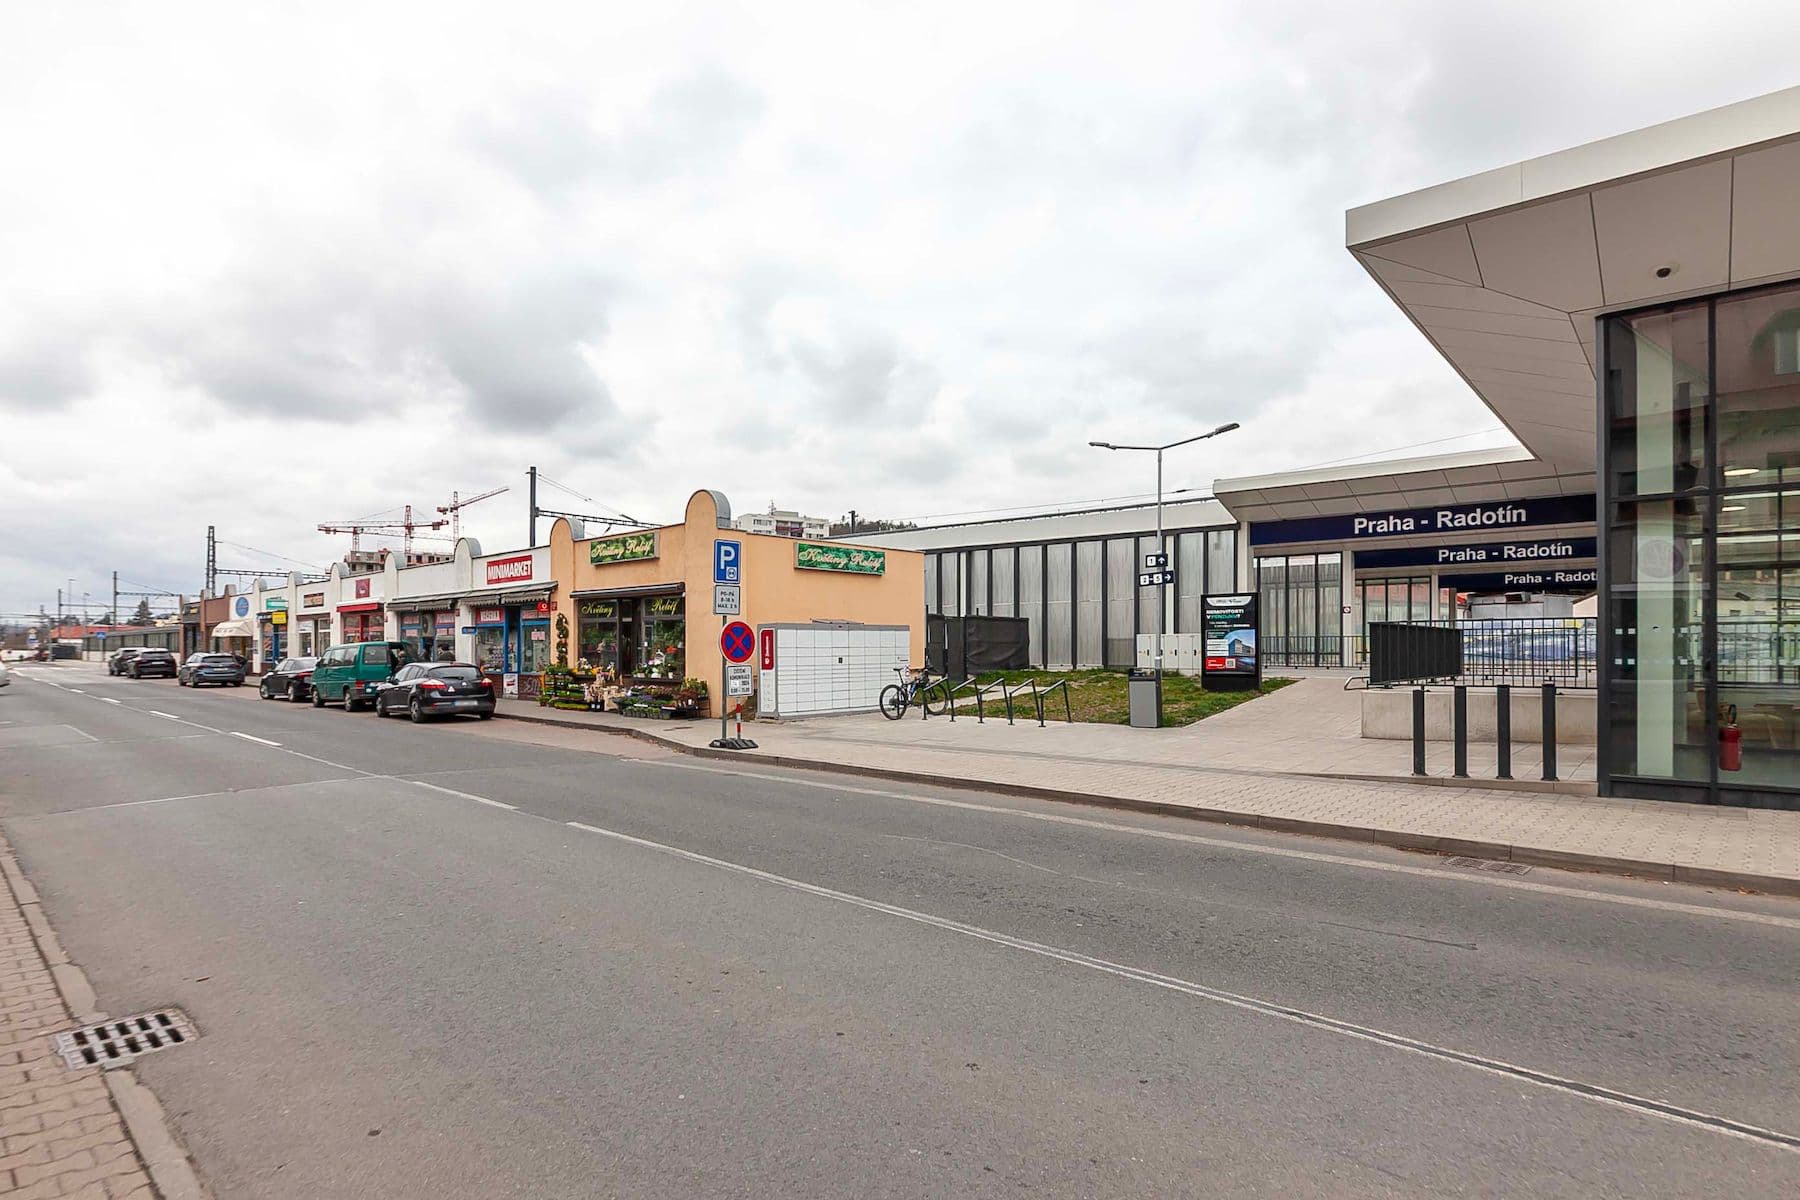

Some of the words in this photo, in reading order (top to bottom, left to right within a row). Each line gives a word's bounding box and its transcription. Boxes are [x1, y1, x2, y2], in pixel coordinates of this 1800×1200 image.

[1354, 516, 1414, 534] Praha
[1436, 505, 1527, 528] Radotín
[720, 545, 736, 570] P
[1438, 548, 1487, 562] Praha
[1503, 542, 1573, 559] Radotín
[487, 560, 532, 580] MINIMARKET
[1504, 573, 1542, 584] Praha
